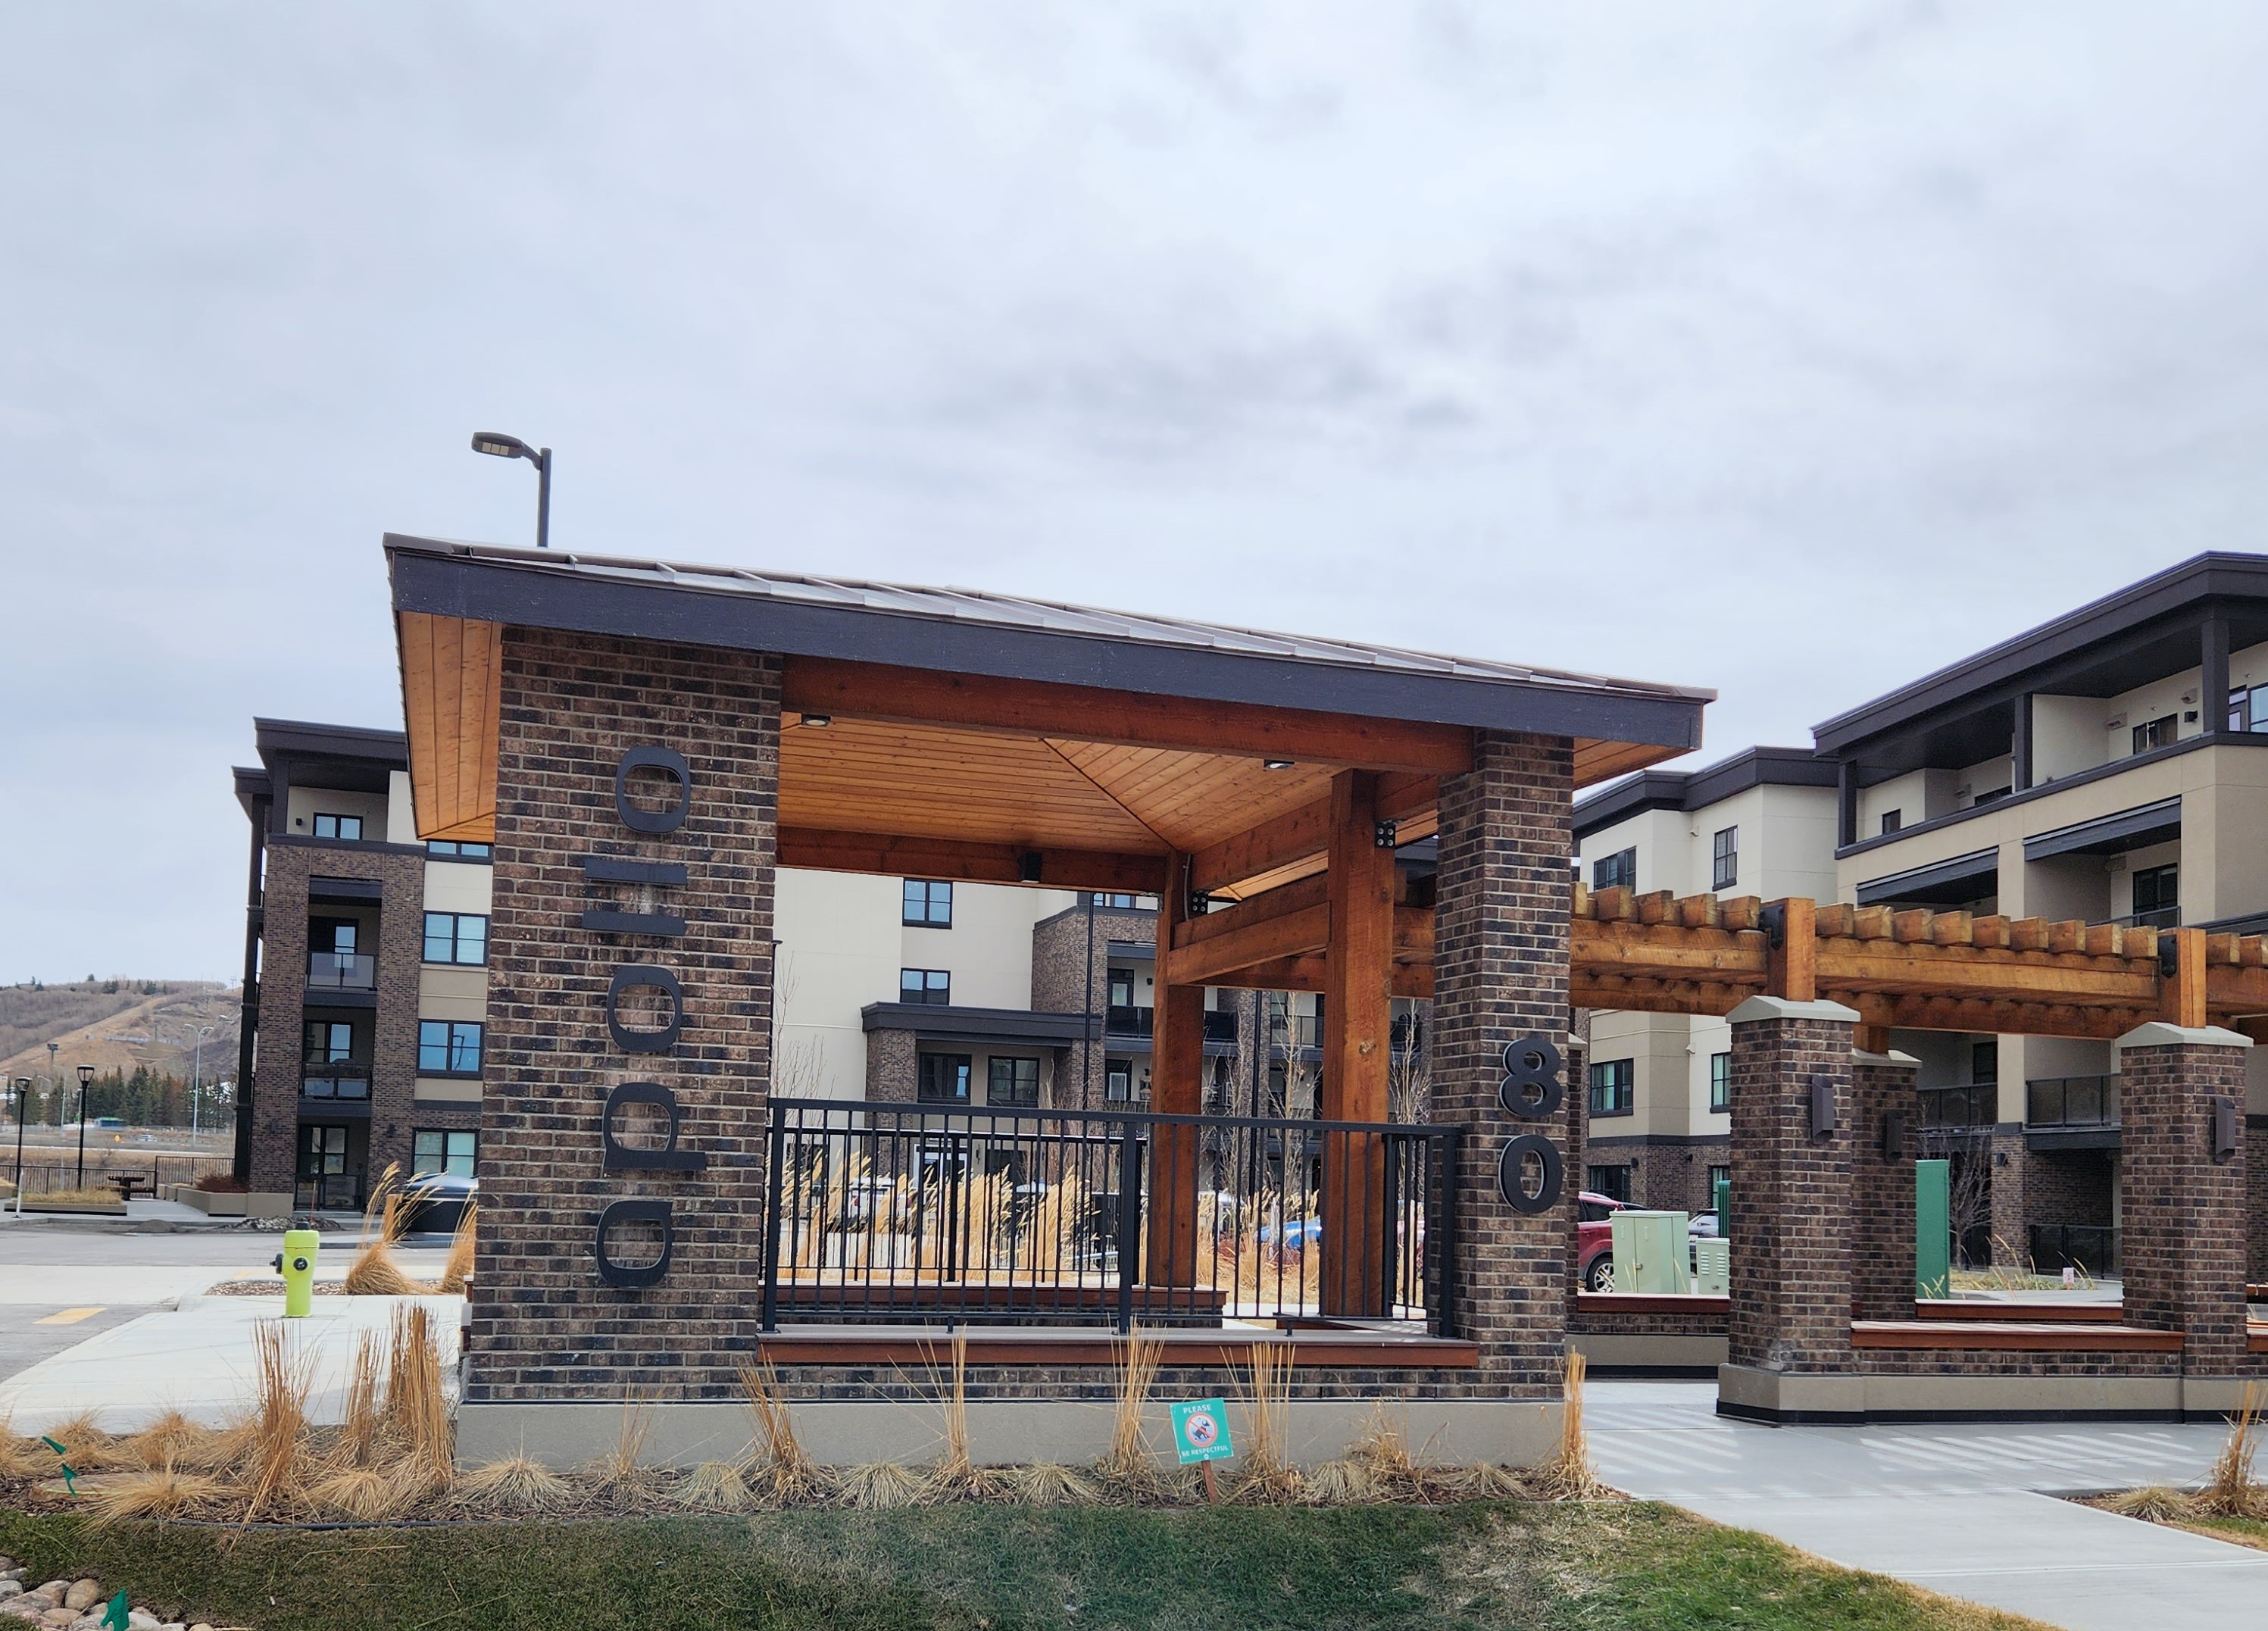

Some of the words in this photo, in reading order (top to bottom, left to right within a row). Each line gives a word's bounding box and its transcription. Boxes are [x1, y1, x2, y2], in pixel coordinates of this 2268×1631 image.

[583, 745, 706, 1288] apollo
[1498, 1038, 1563, 1214] 80
[1183, 1404, 1211, 1414] PLEASE
[1191, 1445, 1229, 1455] RESPECTFUL
